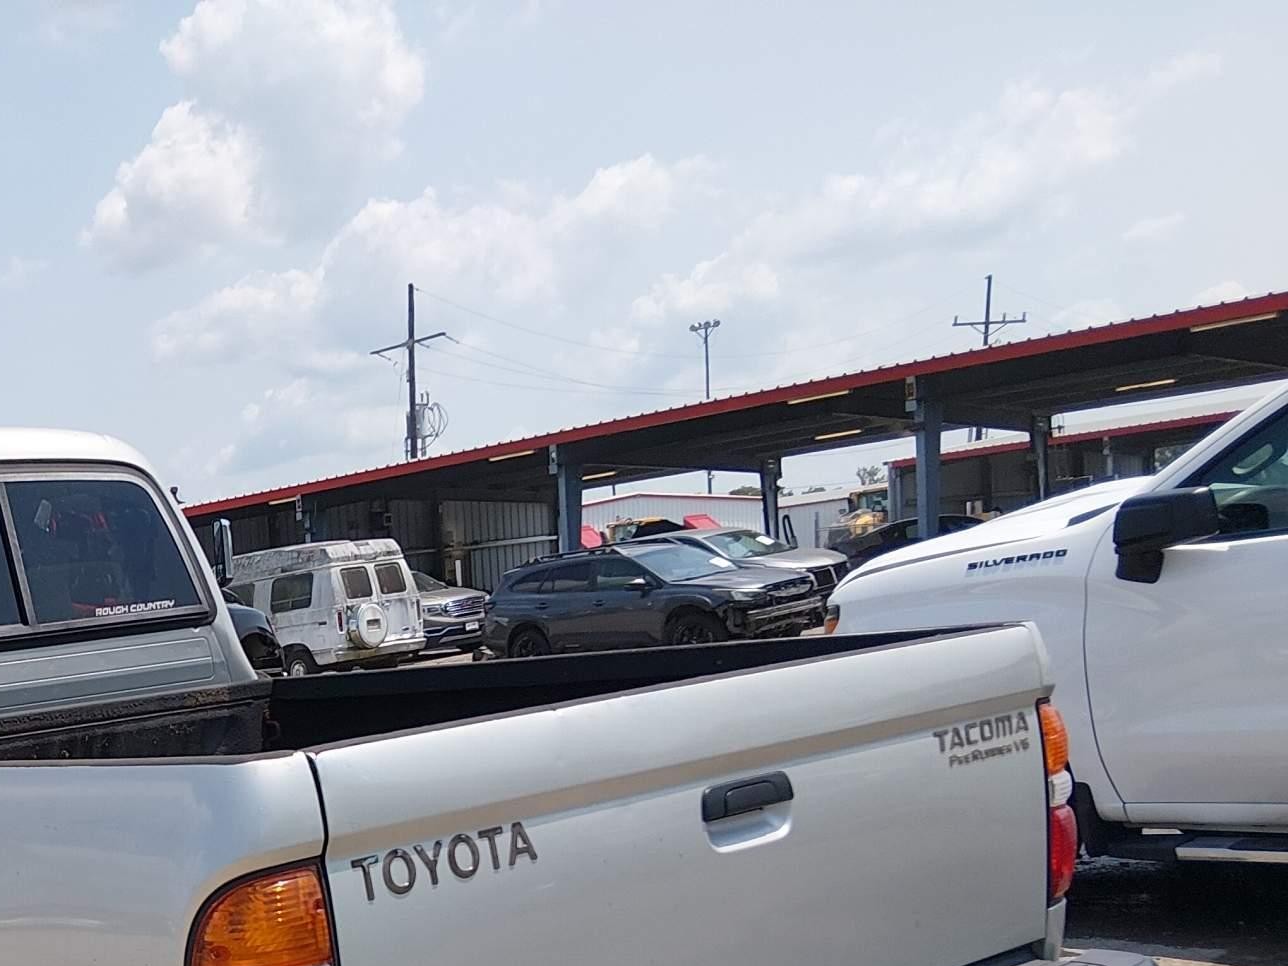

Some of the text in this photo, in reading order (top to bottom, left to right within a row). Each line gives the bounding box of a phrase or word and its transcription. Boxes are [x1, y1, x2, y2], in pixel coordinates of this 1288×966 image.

[967, 548, 1068, 571] SILVERADO
[95, 599, 175, 617] ROUGH COUNTRY
[933, 711, 1029, 753] TACOMA
[350, 821, 538, 902] TOYOTA
